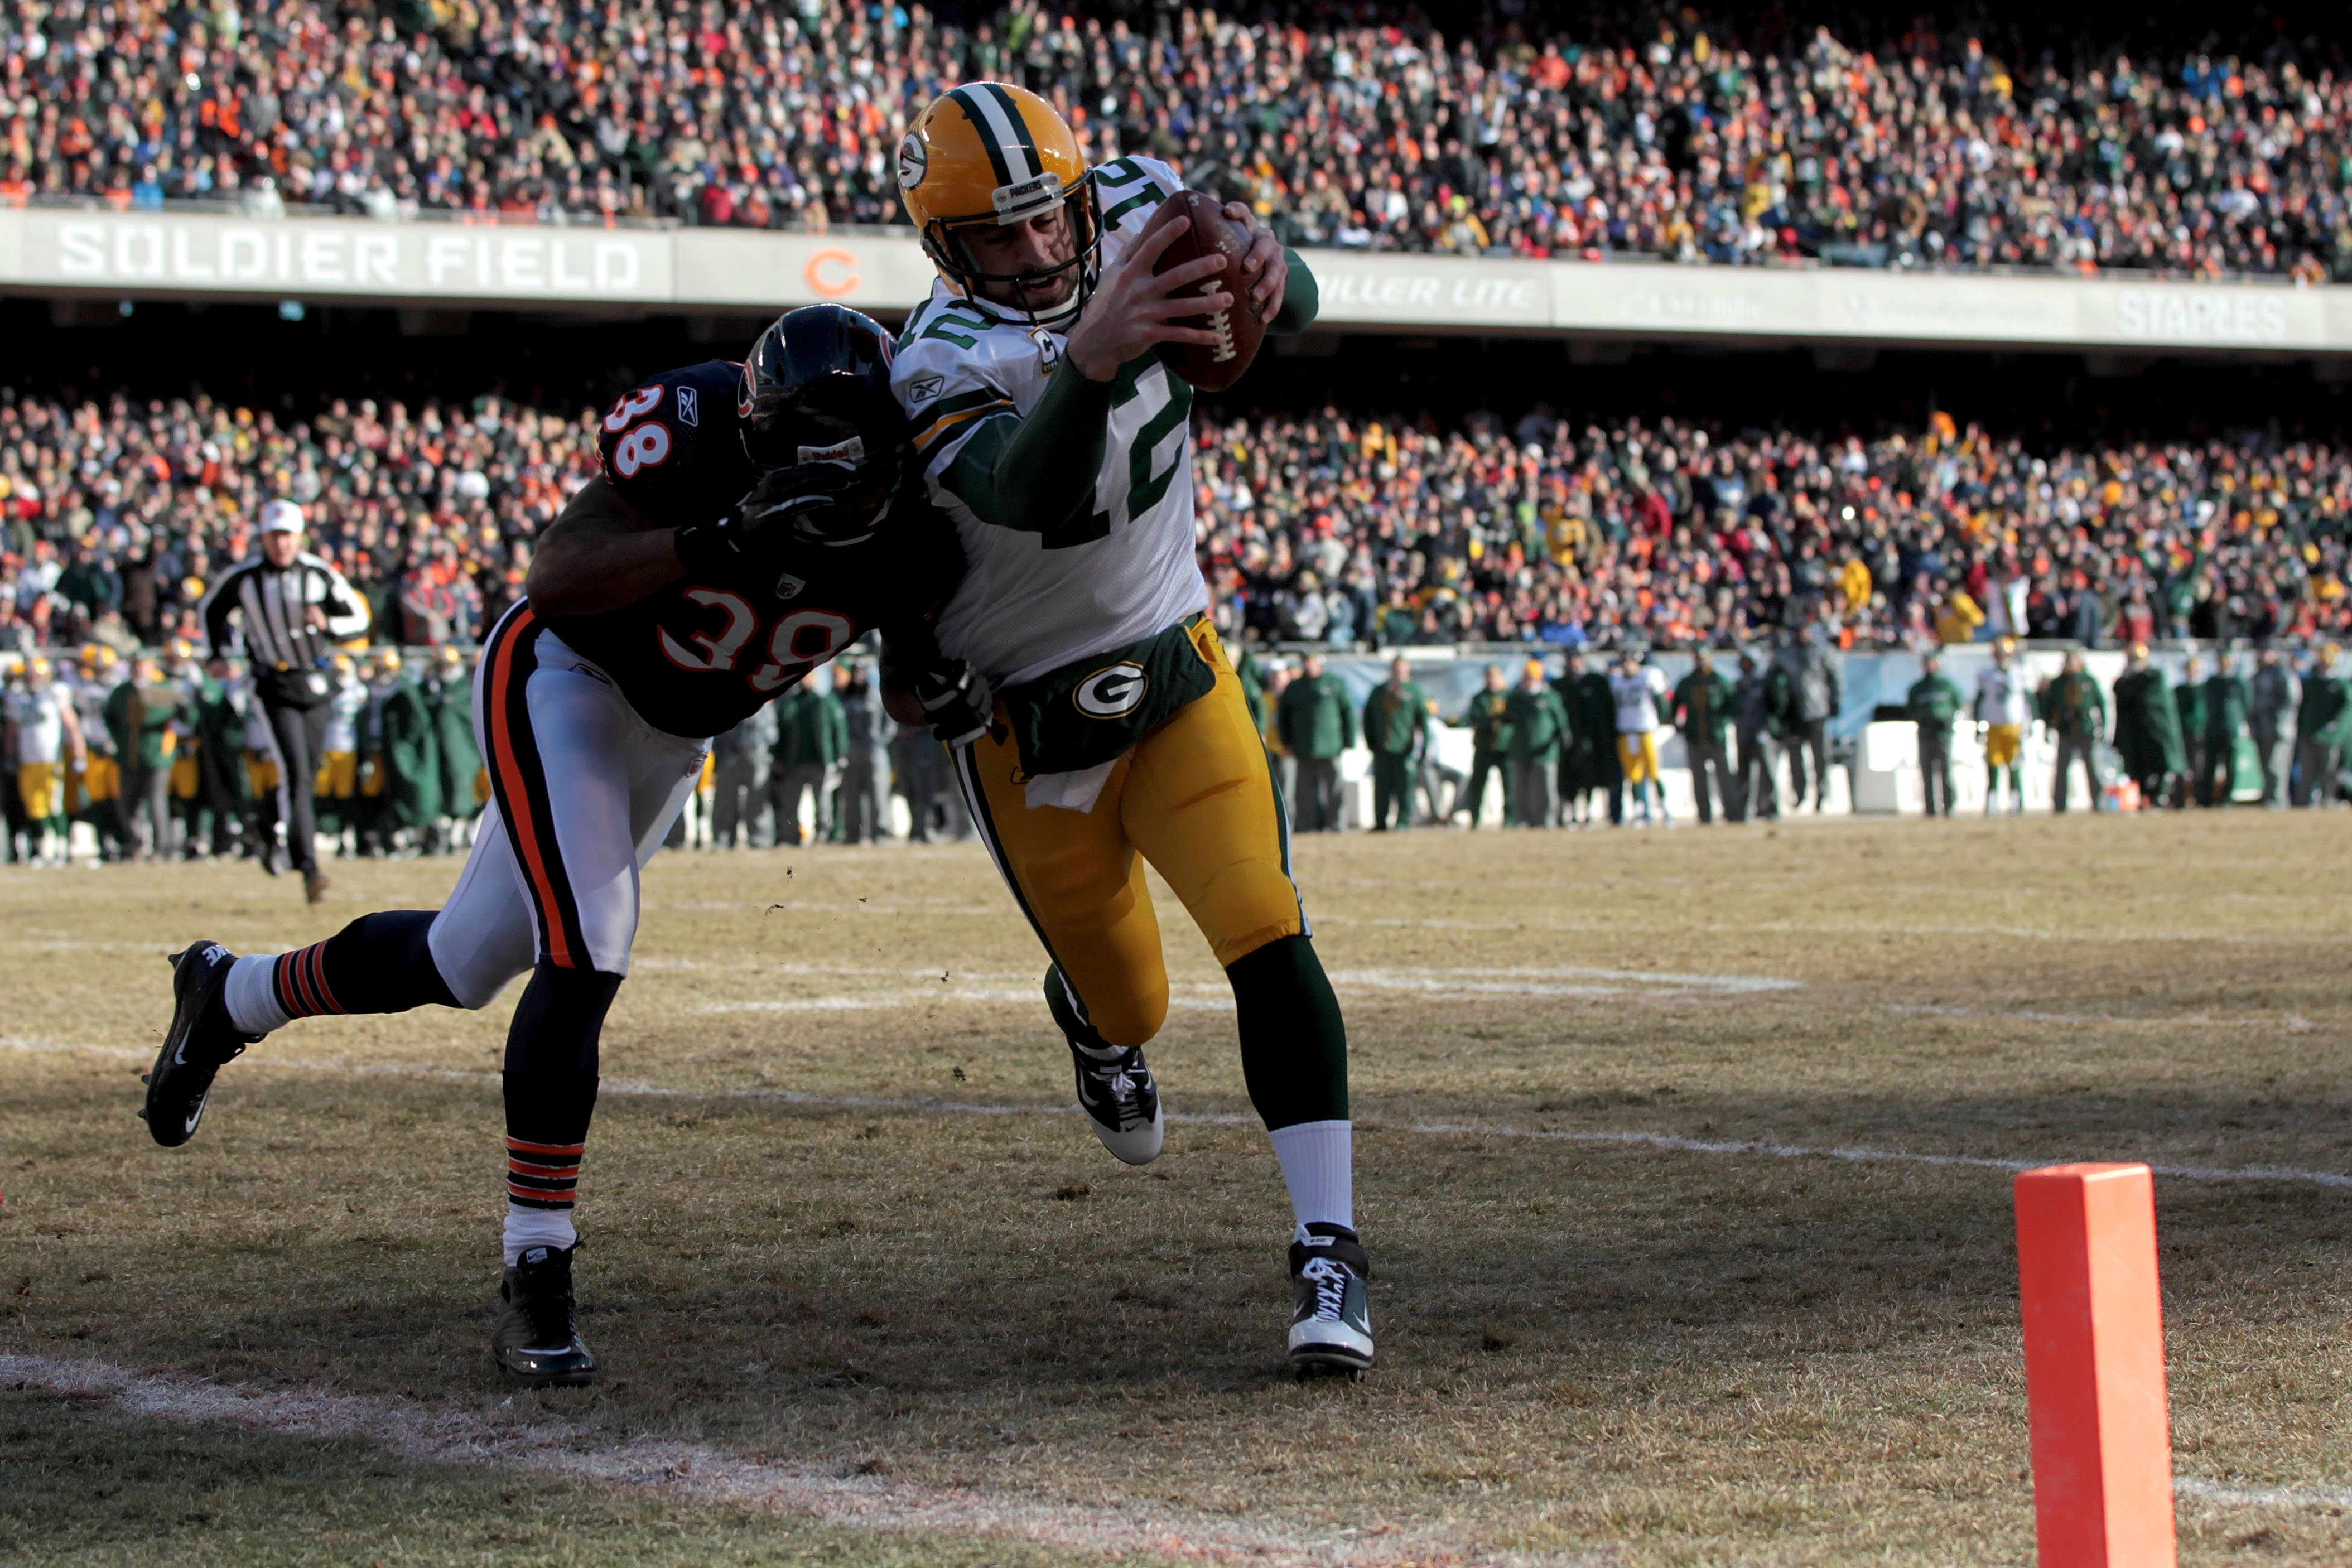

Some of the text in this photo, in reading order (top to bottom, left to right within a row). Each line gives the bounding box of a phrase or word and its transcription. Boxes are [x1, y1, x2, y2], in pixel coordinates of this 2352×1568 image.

[1010, 179, 1043, 199] PACKERS
[59, 224, 639, 290] SOLDIER FIELD
[803, 247, 861, 298] C
[1450, 277, 1538, 310] LITE
[2116, 288, 2286, 340] STAPLES
[603, 383, 672, 479] 38
[1078, 665, 1144, 714] G
